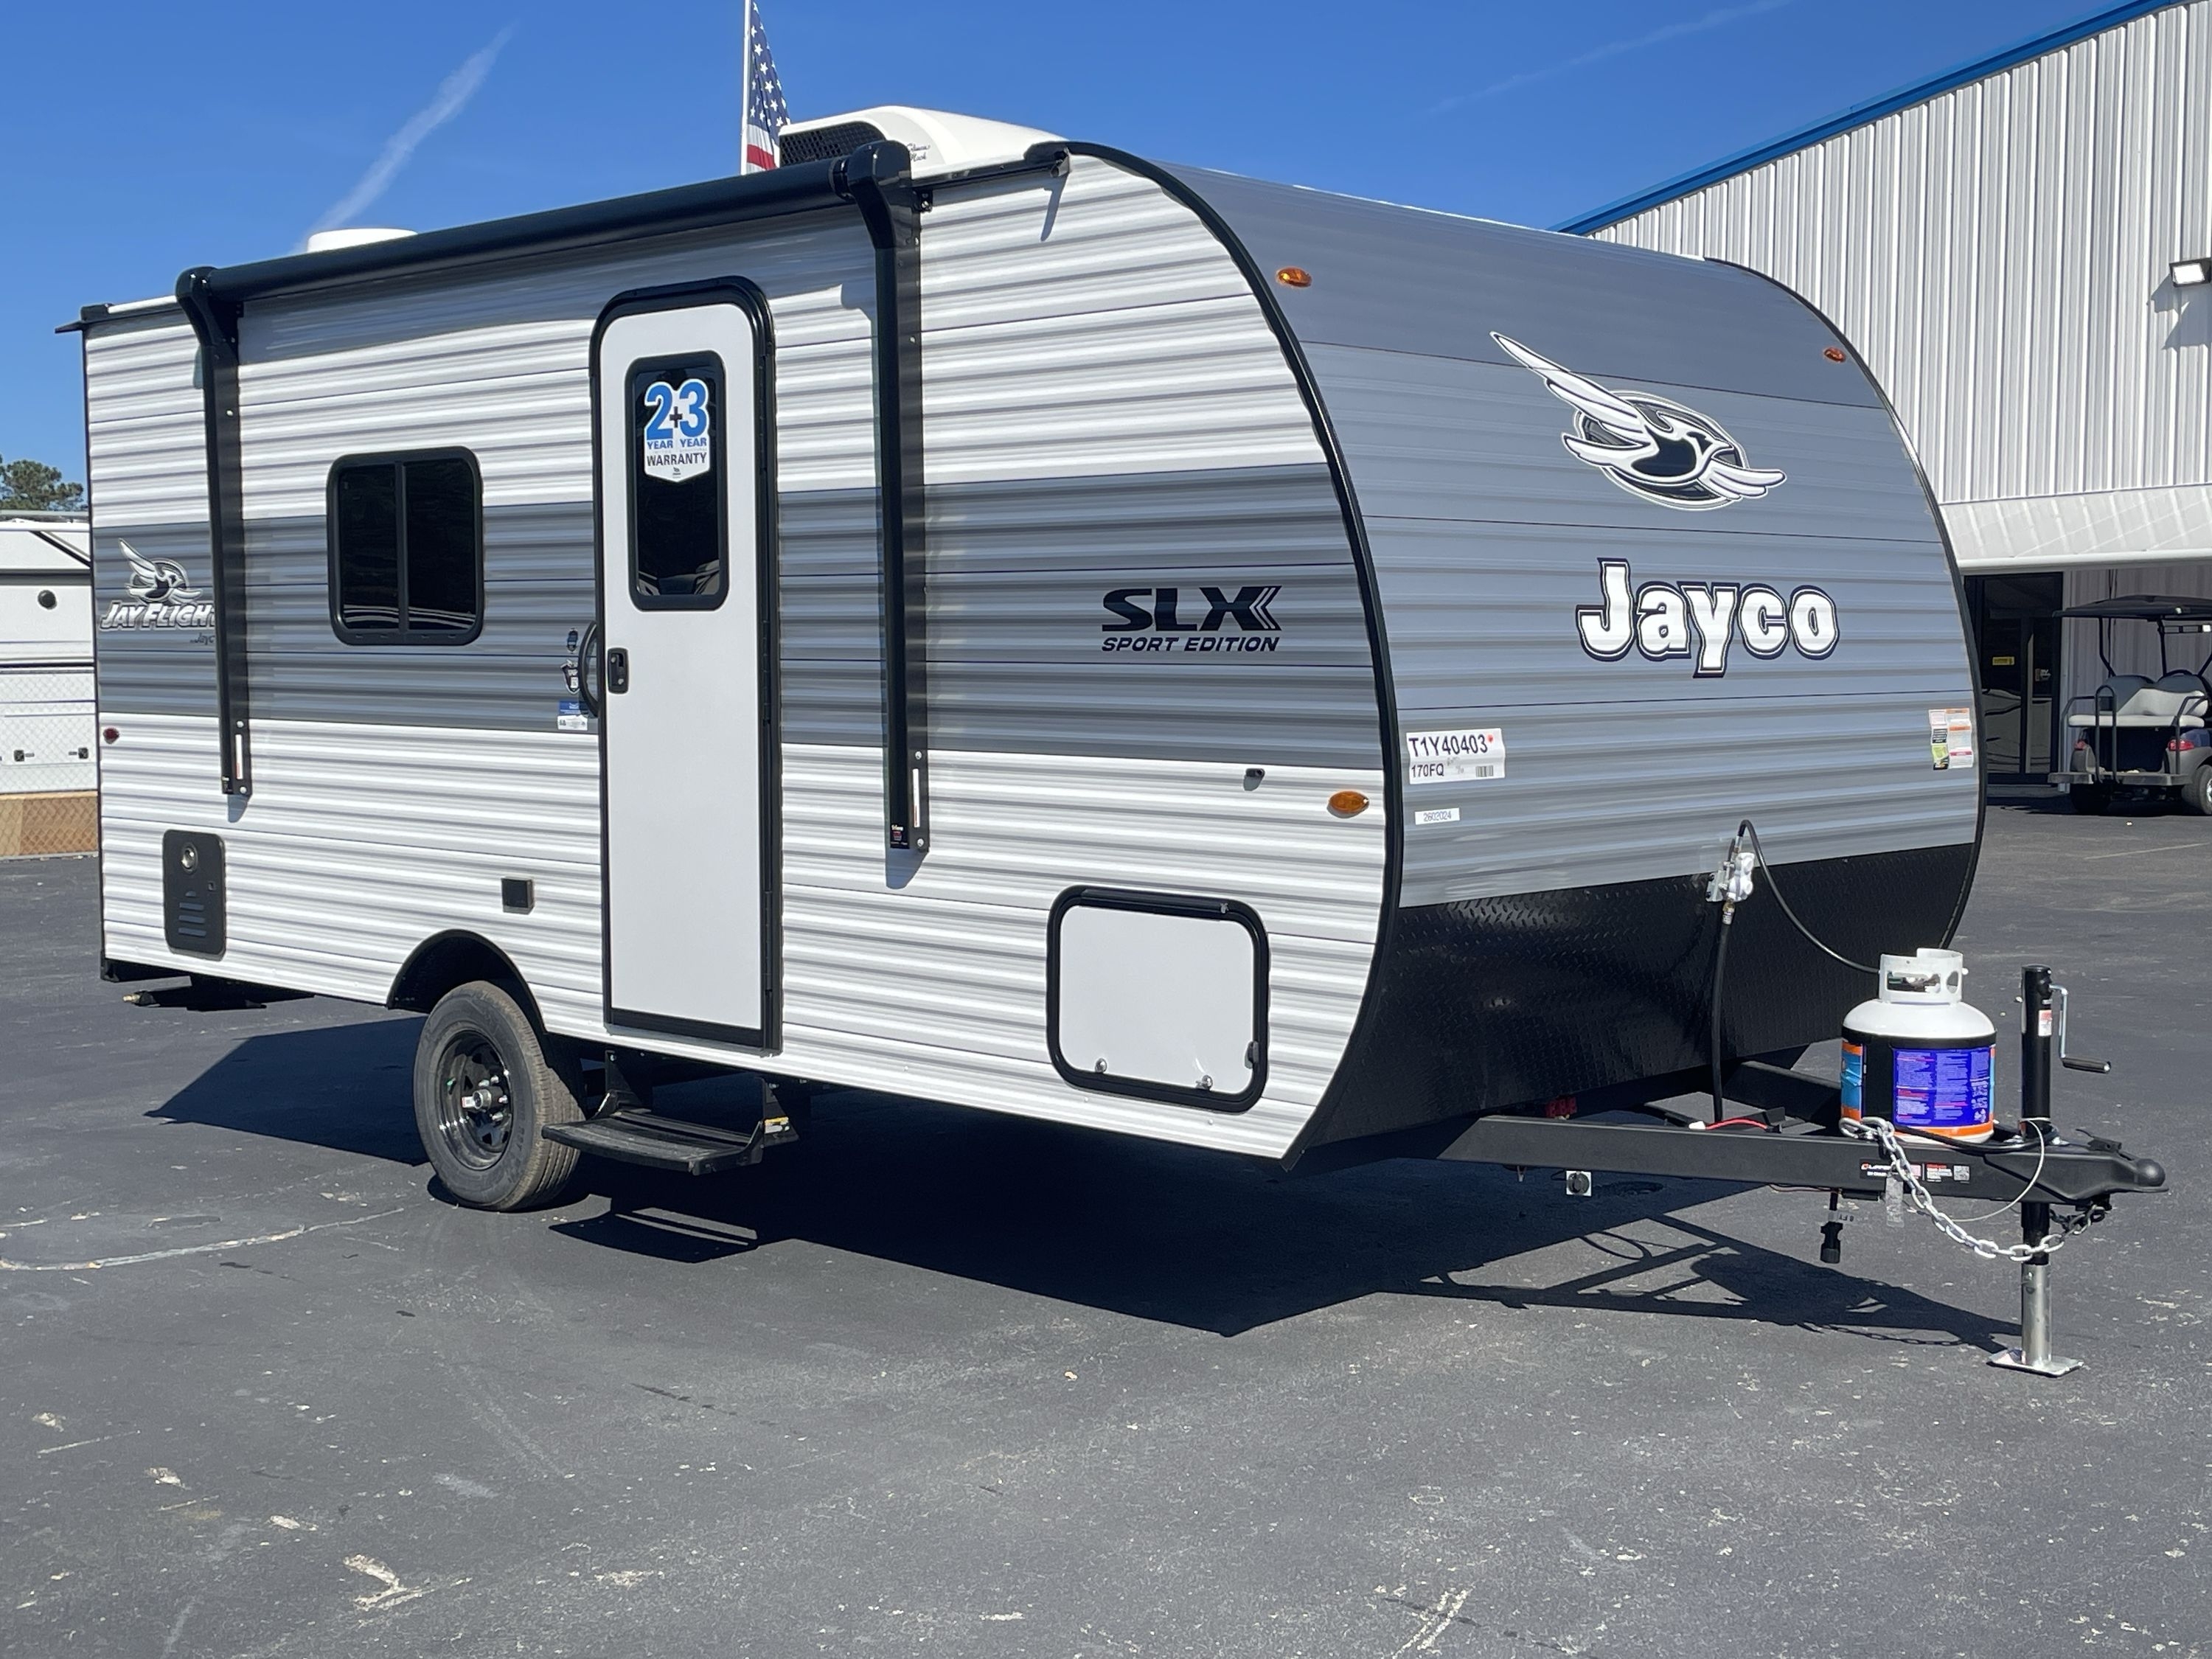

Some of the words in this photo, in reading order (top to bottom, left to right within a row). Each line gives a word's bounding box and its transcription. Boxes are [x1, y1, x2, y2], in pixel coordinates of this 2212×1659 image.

[647, 440, 673, 450] YEAR
[679, 437, 707, 448] YEAR
[647, 452, 707, 467] WARRANTY
[100, 602, 145, 629] JAY
[1102, 585, 1282, 632] SLX
[1576, 557, 1839, 678] Jayco
[196, 633, 215, 646] Jayc
[1102, 637, 1179, 652] SPORT
[1183, 637, 1280, 652] EDITION
[1408, 734, 1488, 757] T1Y40403
[1411, 763, 1444, 778] 170FQ
